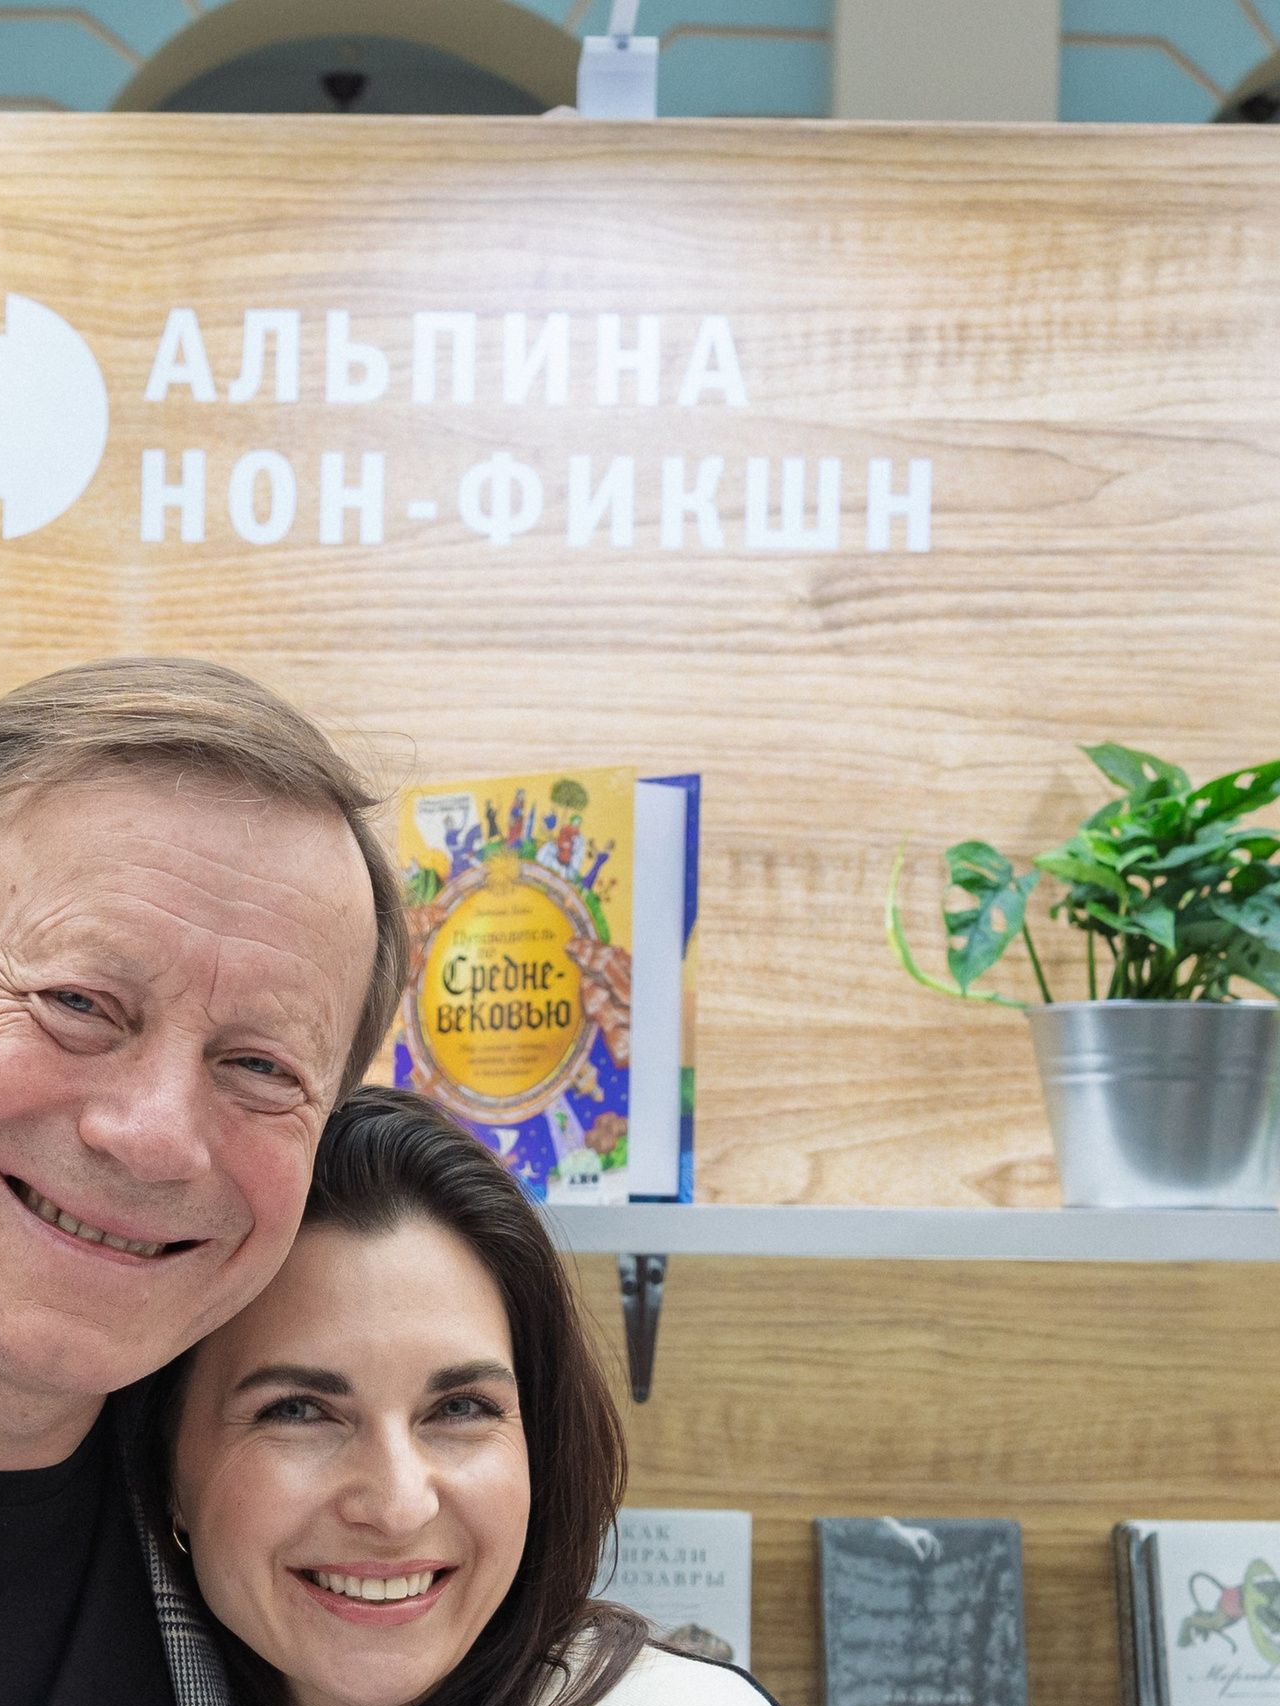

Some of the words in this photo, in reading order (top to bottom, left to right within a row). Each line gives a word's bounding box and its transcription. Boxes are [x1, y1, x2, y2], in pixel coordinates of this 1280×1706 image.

[143, 307, 750, 408] АЛЬПИНА
[141, 448, 933, 554] НОН-ФИКШН
[442, 953, 565, 1002] Средне-
[436, 998, 572, 1034] вековью
[621, 1523, 670, 1540] КАК
[606, 1547, 707, 1564] ИРАЛИ
